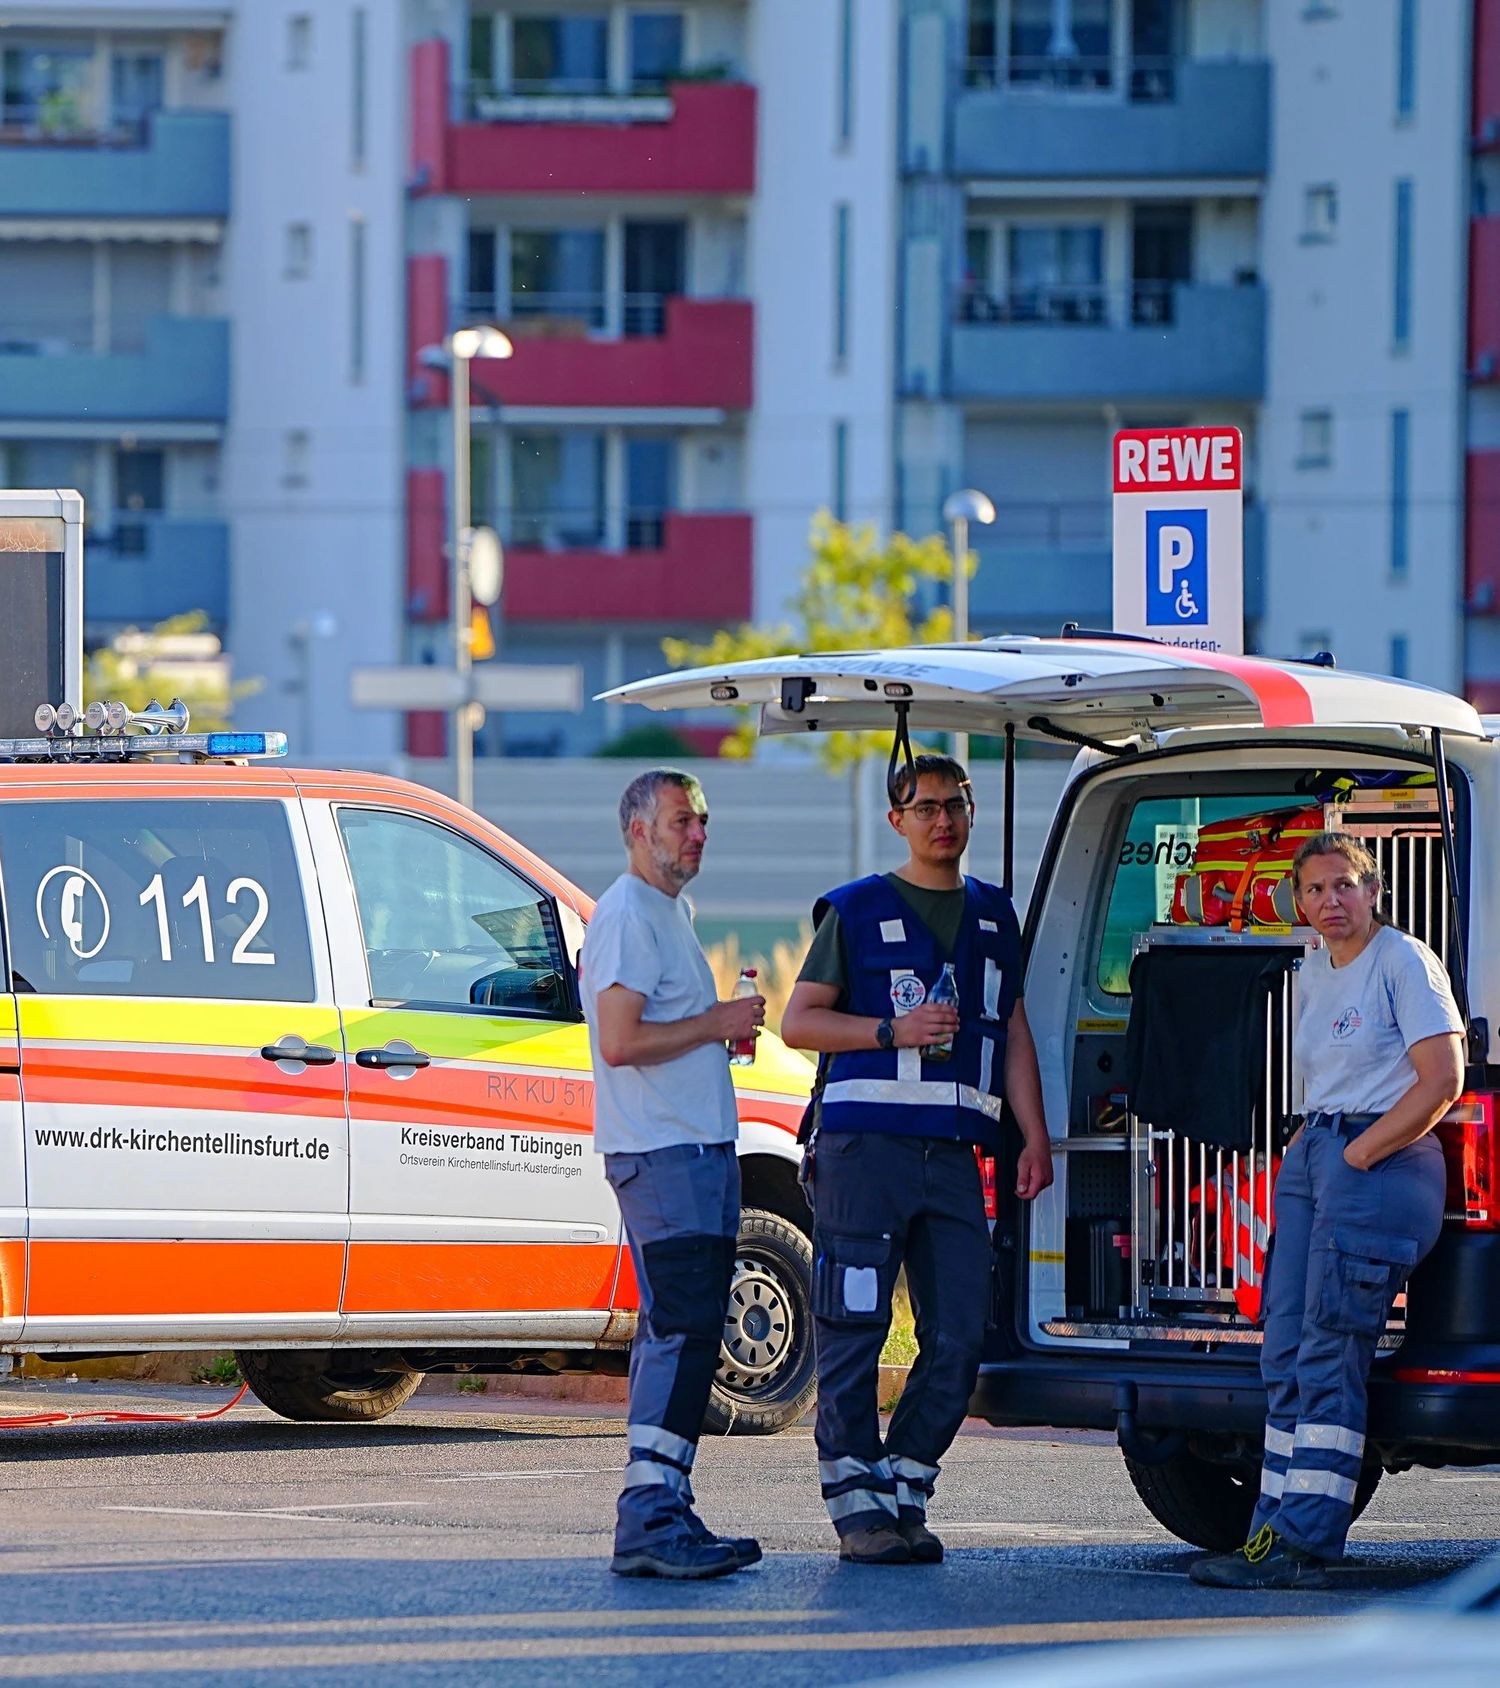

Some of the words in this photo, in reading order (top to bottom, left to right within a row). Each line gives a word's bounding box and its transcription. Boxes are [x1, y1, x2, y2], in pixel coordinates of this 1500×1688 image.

[1119, 436, 1235, 483] REWE
[1159, 525, 1194, 593] P
[139, 874, 276, 965] 112
[487, 1075, 518, 1102] RK
[526, 1078, 556, 1104] KU
[35, 1127, 329, 1160] www.drk-kirchentellinsfurt.de
[401, 1127, 505, 1152] Kreisverband
[510, 1135, 582, 1160] Tübingen
[399, 1153, 445, 1167] Ortsverein
[447, 1156, 582, 1179] Kirchentellinsfurt-Kusterdingen
